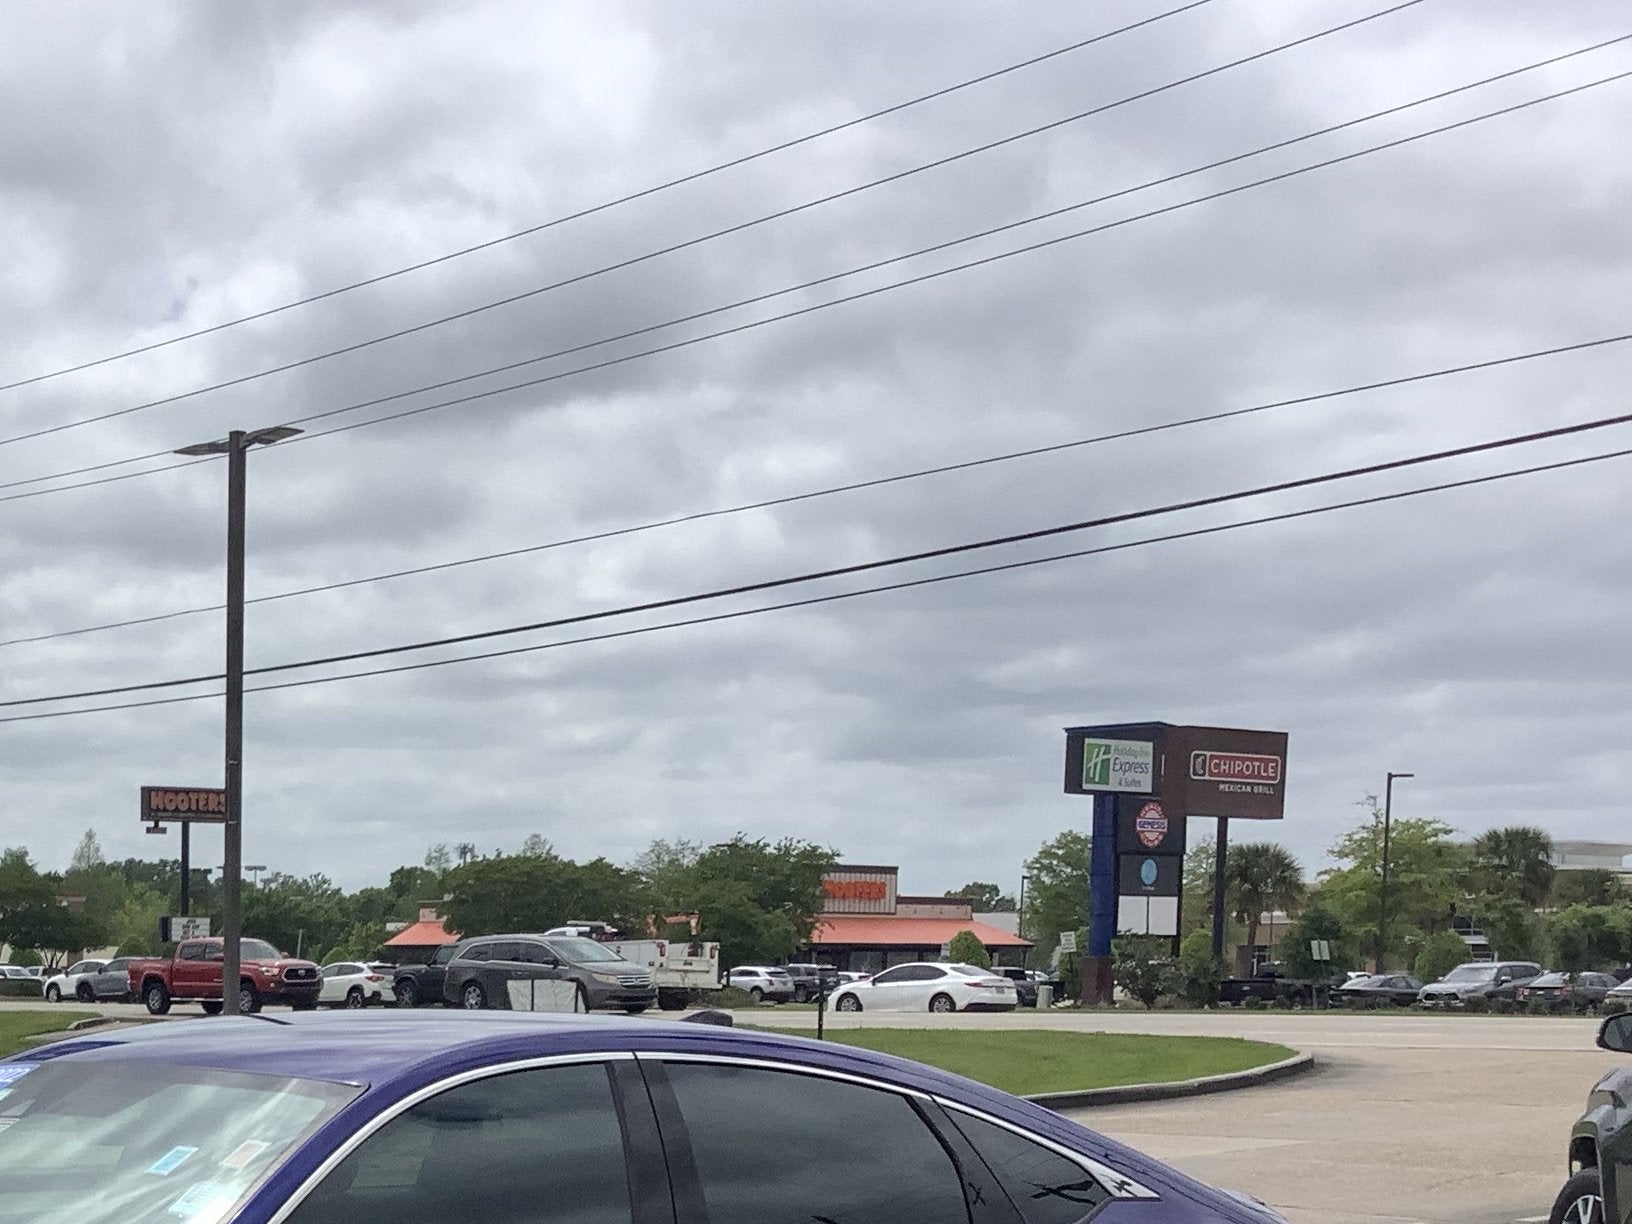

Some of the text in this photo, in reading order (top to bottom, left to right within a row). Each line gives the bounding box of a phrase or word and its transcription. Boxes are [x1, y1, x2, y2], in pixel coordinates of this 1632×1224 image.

[1112, 757, 1151, 776] Express
[1210, 759, 1277, 777] CHIPOTLE
[1218, 783, 1275, 795] MEXICAN GRILL
